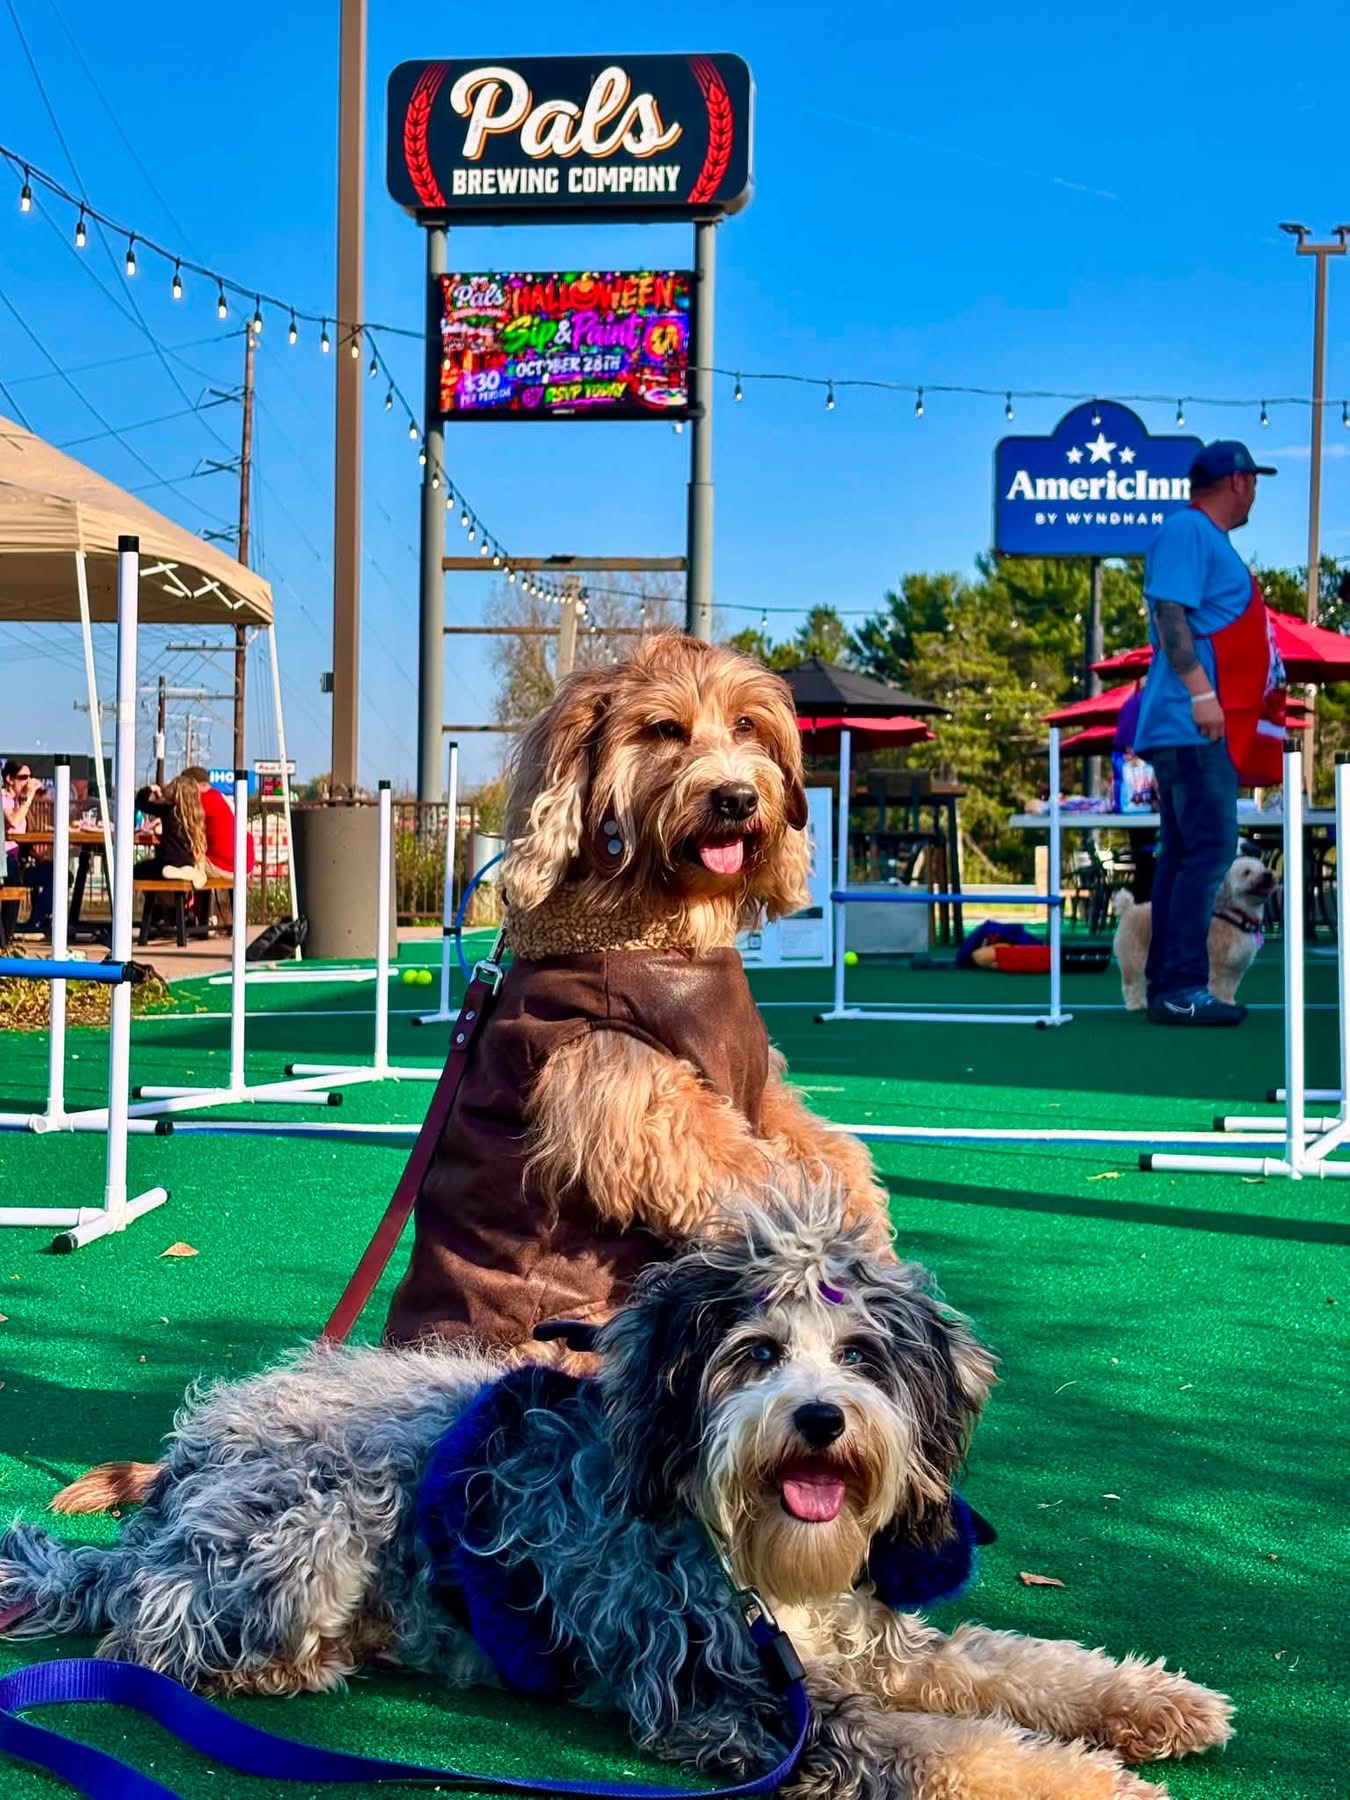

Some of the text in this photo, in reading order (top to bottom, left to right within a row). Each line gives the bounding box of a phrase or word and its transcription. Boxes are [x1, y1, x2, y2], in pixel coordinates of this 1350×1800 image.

[450, 66, 682, 159] Pals
[452, 166, 681, 195] BREWING COMPANY
[453, 283, 506, 308] Pals
[512, 276, 673, 317] HALLOWEEN
[1006, 469, 1192, 501] AmericInn
[1035, 512, 1164, 526] BY WYNDHAM
[209, 770, 235, 785] IHO
